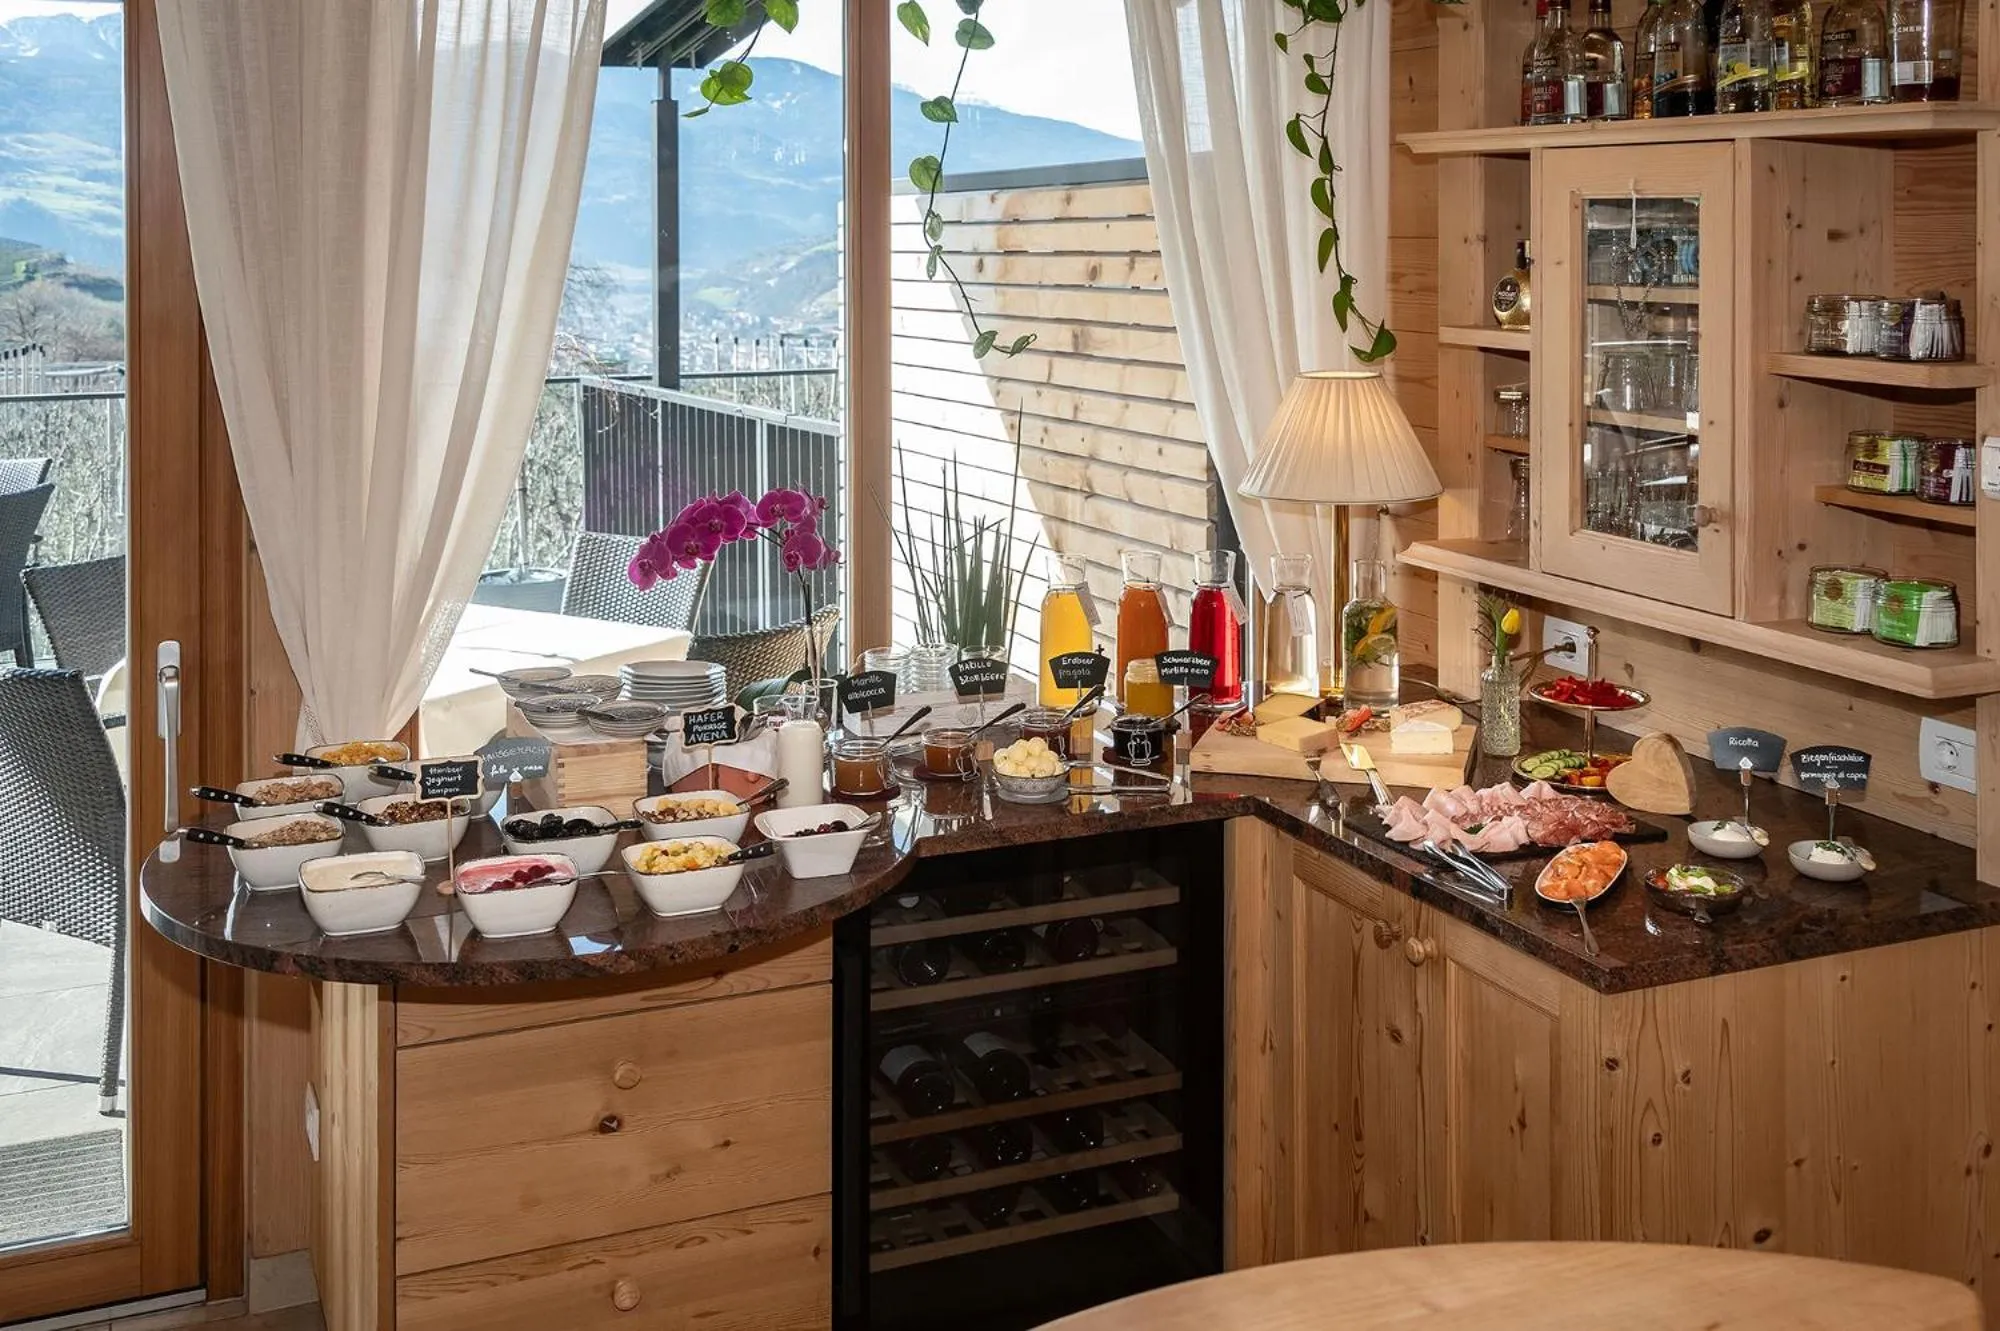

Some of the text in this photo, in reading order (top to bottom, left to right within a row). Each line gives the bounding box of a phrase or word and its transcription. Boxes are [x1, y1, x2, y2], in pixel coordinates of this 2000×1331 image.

[688, 711, 725, 725] HAFER
[688, 729, 729, 744] AVENA
[1728, 736, 1760, 748] Ricotta
